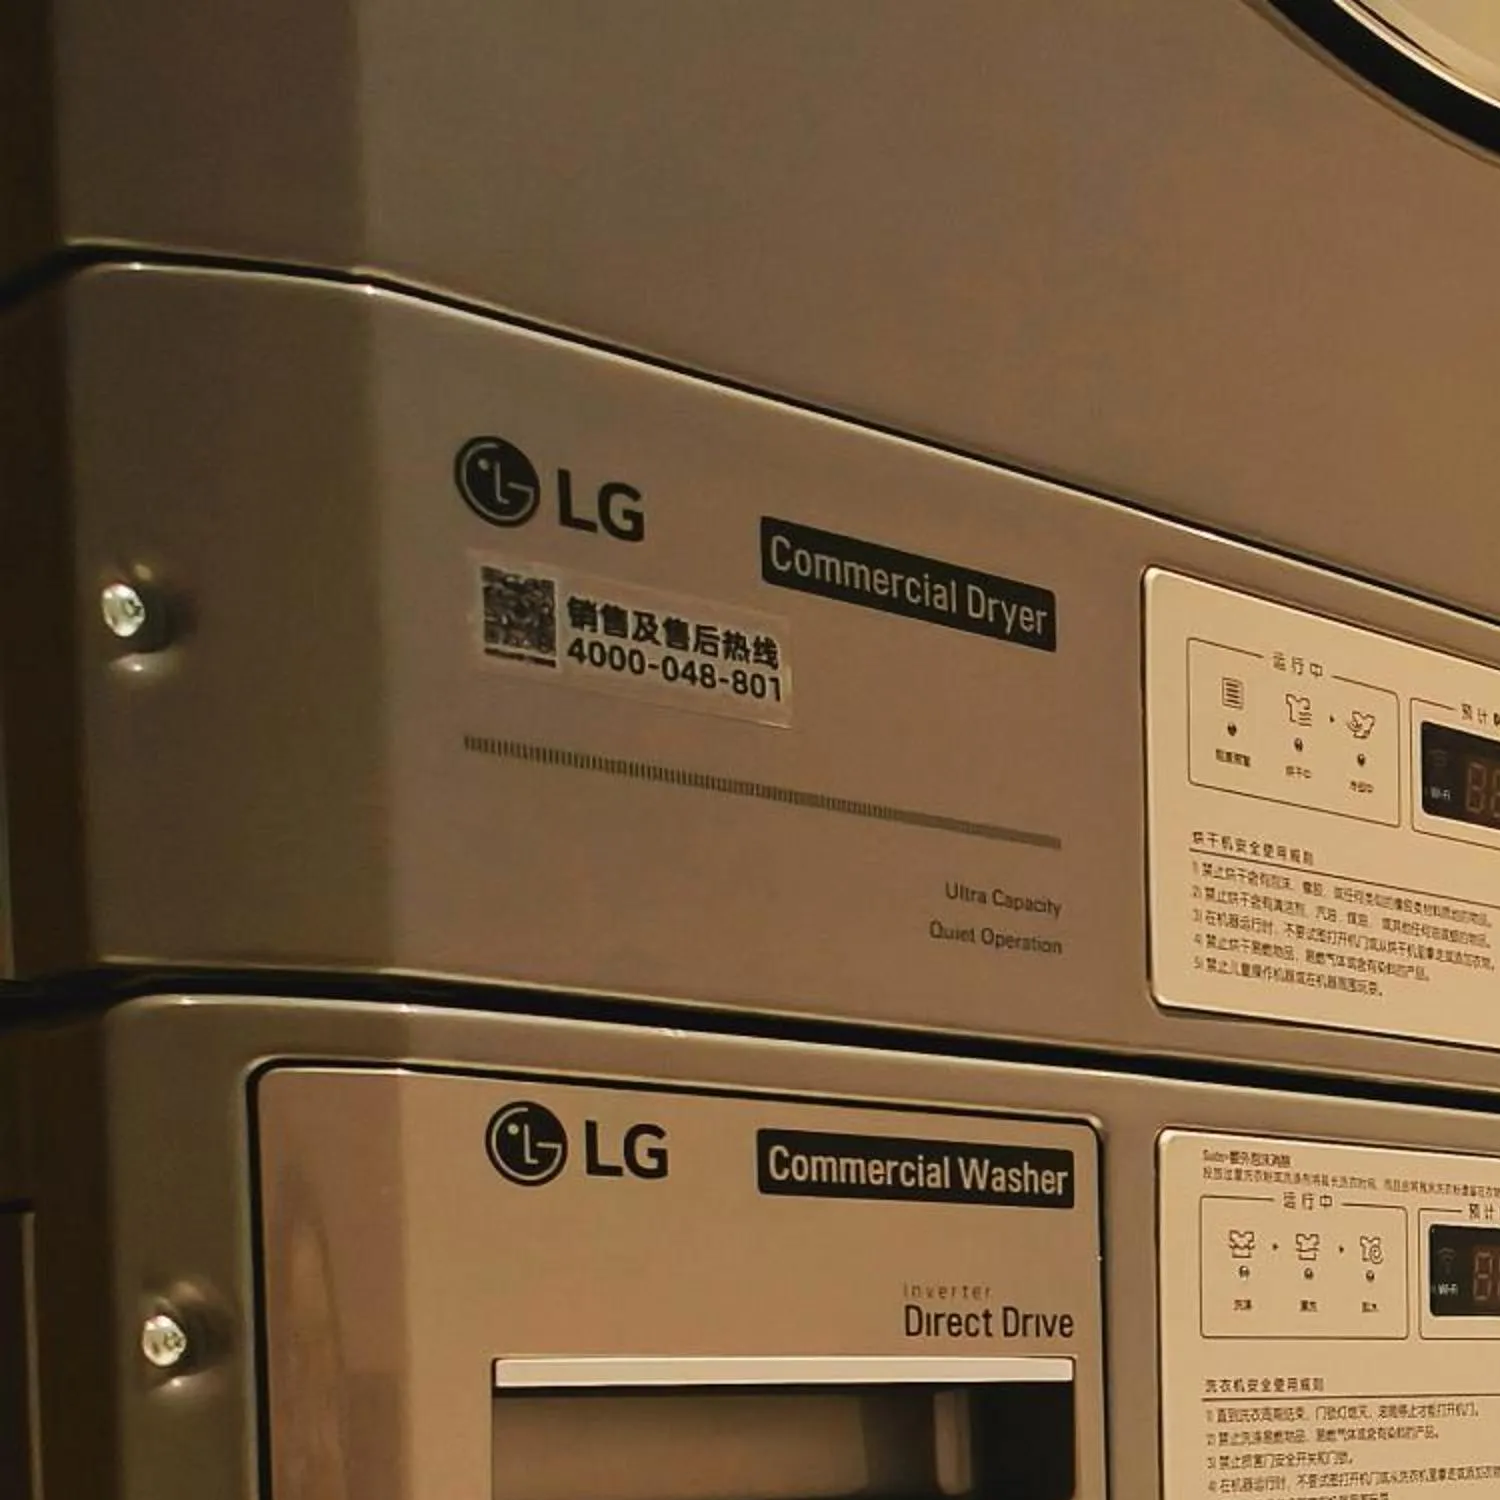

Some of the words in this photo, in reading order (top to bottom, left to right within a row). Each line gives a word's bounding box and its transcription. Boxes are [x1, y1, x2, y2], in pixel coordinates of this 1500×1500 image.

[557, 468, 645, 542] LG
[770, 535, 958, 613] Commercial
[966, 583, 1047, 636] Dryer
[567, 596, 779, 670] 销售及售后热线
[567, 637, 781, 702] 4000-048-801
[945, 881, 987, 905] Ultra
[992, 888, 1062, 919] Capacity
[929, 919, 975, 943] Quiet
[981, 927, 1063, 954] Operation
[585, 1120, 669, 1179] LG
[768, 1144, 951, 1189] Commercial
[958, 1156, 1069, 1197] Washer
[903, 1282, 993, 1300] Inverter
[904, 1304, 993, 1338] Direct
[1003, 1305, 1075, 1338] Drive
